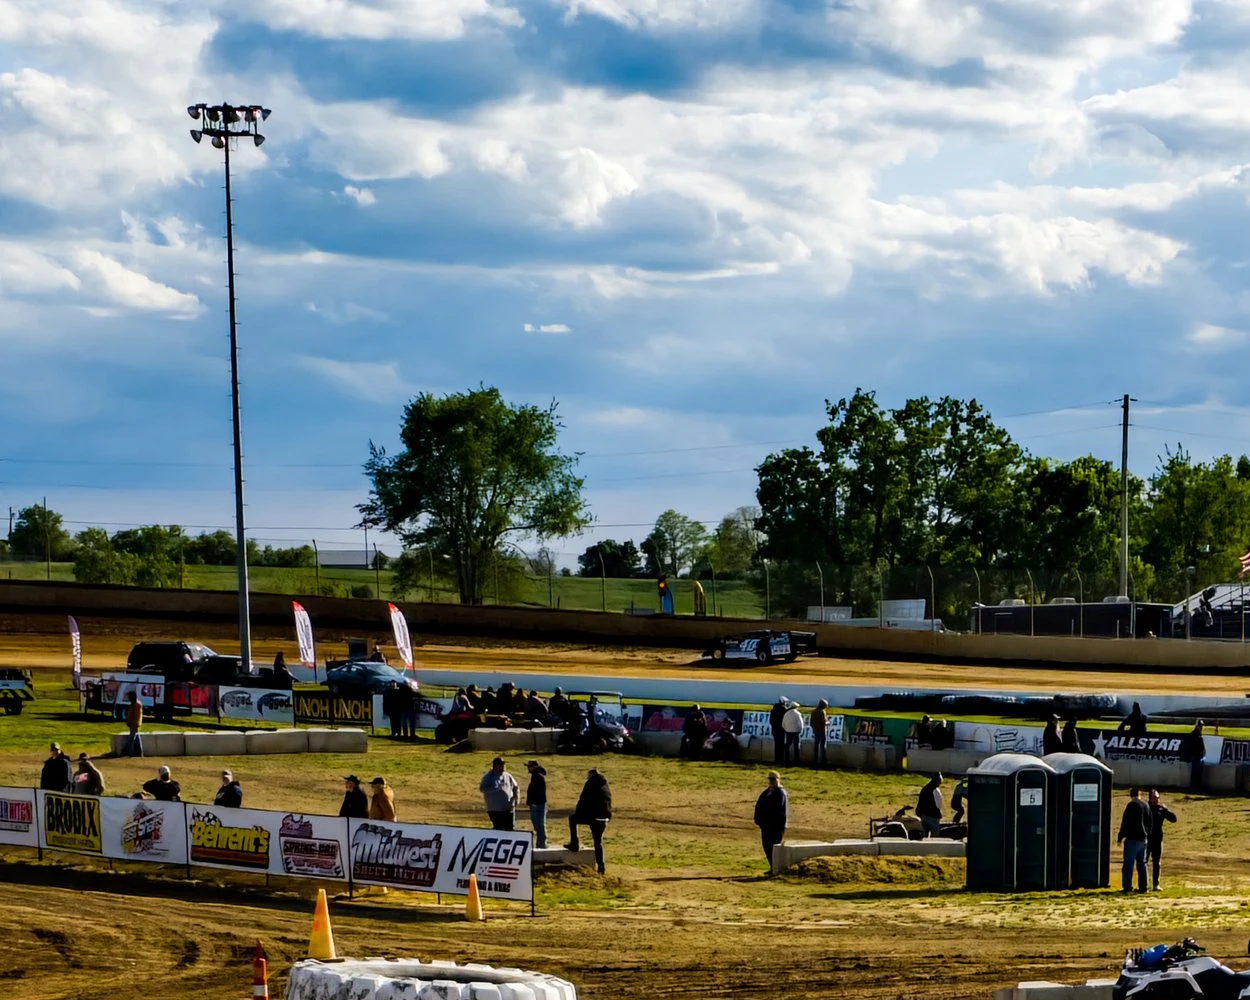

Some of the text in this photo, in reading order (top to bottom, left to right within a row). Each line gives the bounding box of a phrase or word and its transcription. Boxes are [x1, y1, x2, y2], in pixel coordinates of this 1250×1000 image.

[295, 697, 371, 720] UNOH UNOH
[1106, 735, 1181, 751] ALLSTAR
[46, 796, 98, 838] BRODIX
[352, 823, 442, 870] Midwest
[447, 836, 529, 875] MEGA
[354, 864, 431, 882] SHEET METAL
